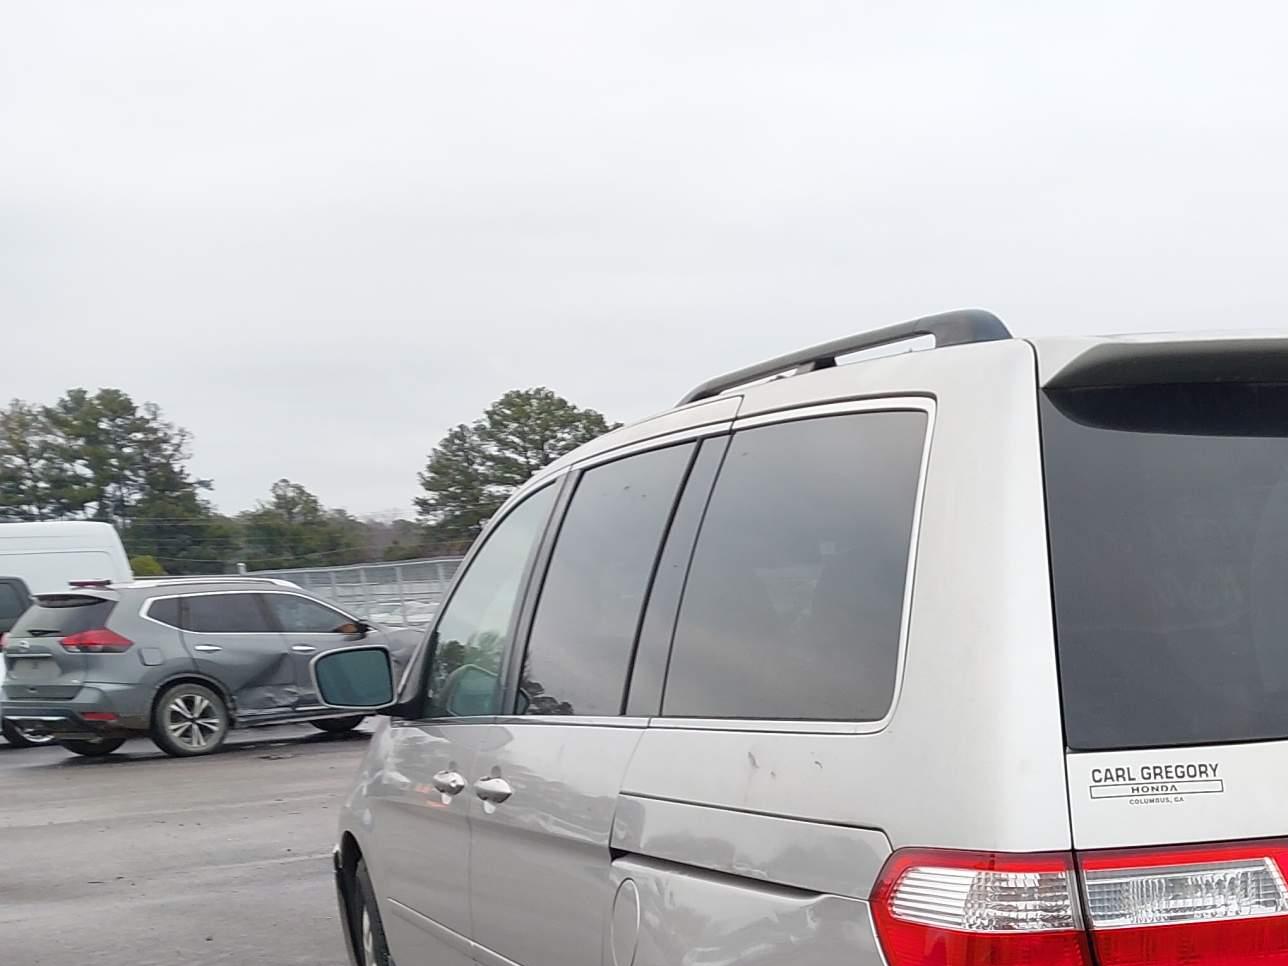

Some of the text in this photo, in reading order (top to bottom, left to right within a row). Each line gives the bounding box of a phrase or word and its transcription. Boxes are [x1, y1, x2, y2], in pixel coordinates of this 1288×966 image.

[1091, 763, 1219, 783] CARL GREGORY
[1131, 784, 1178, 794] HONDA
